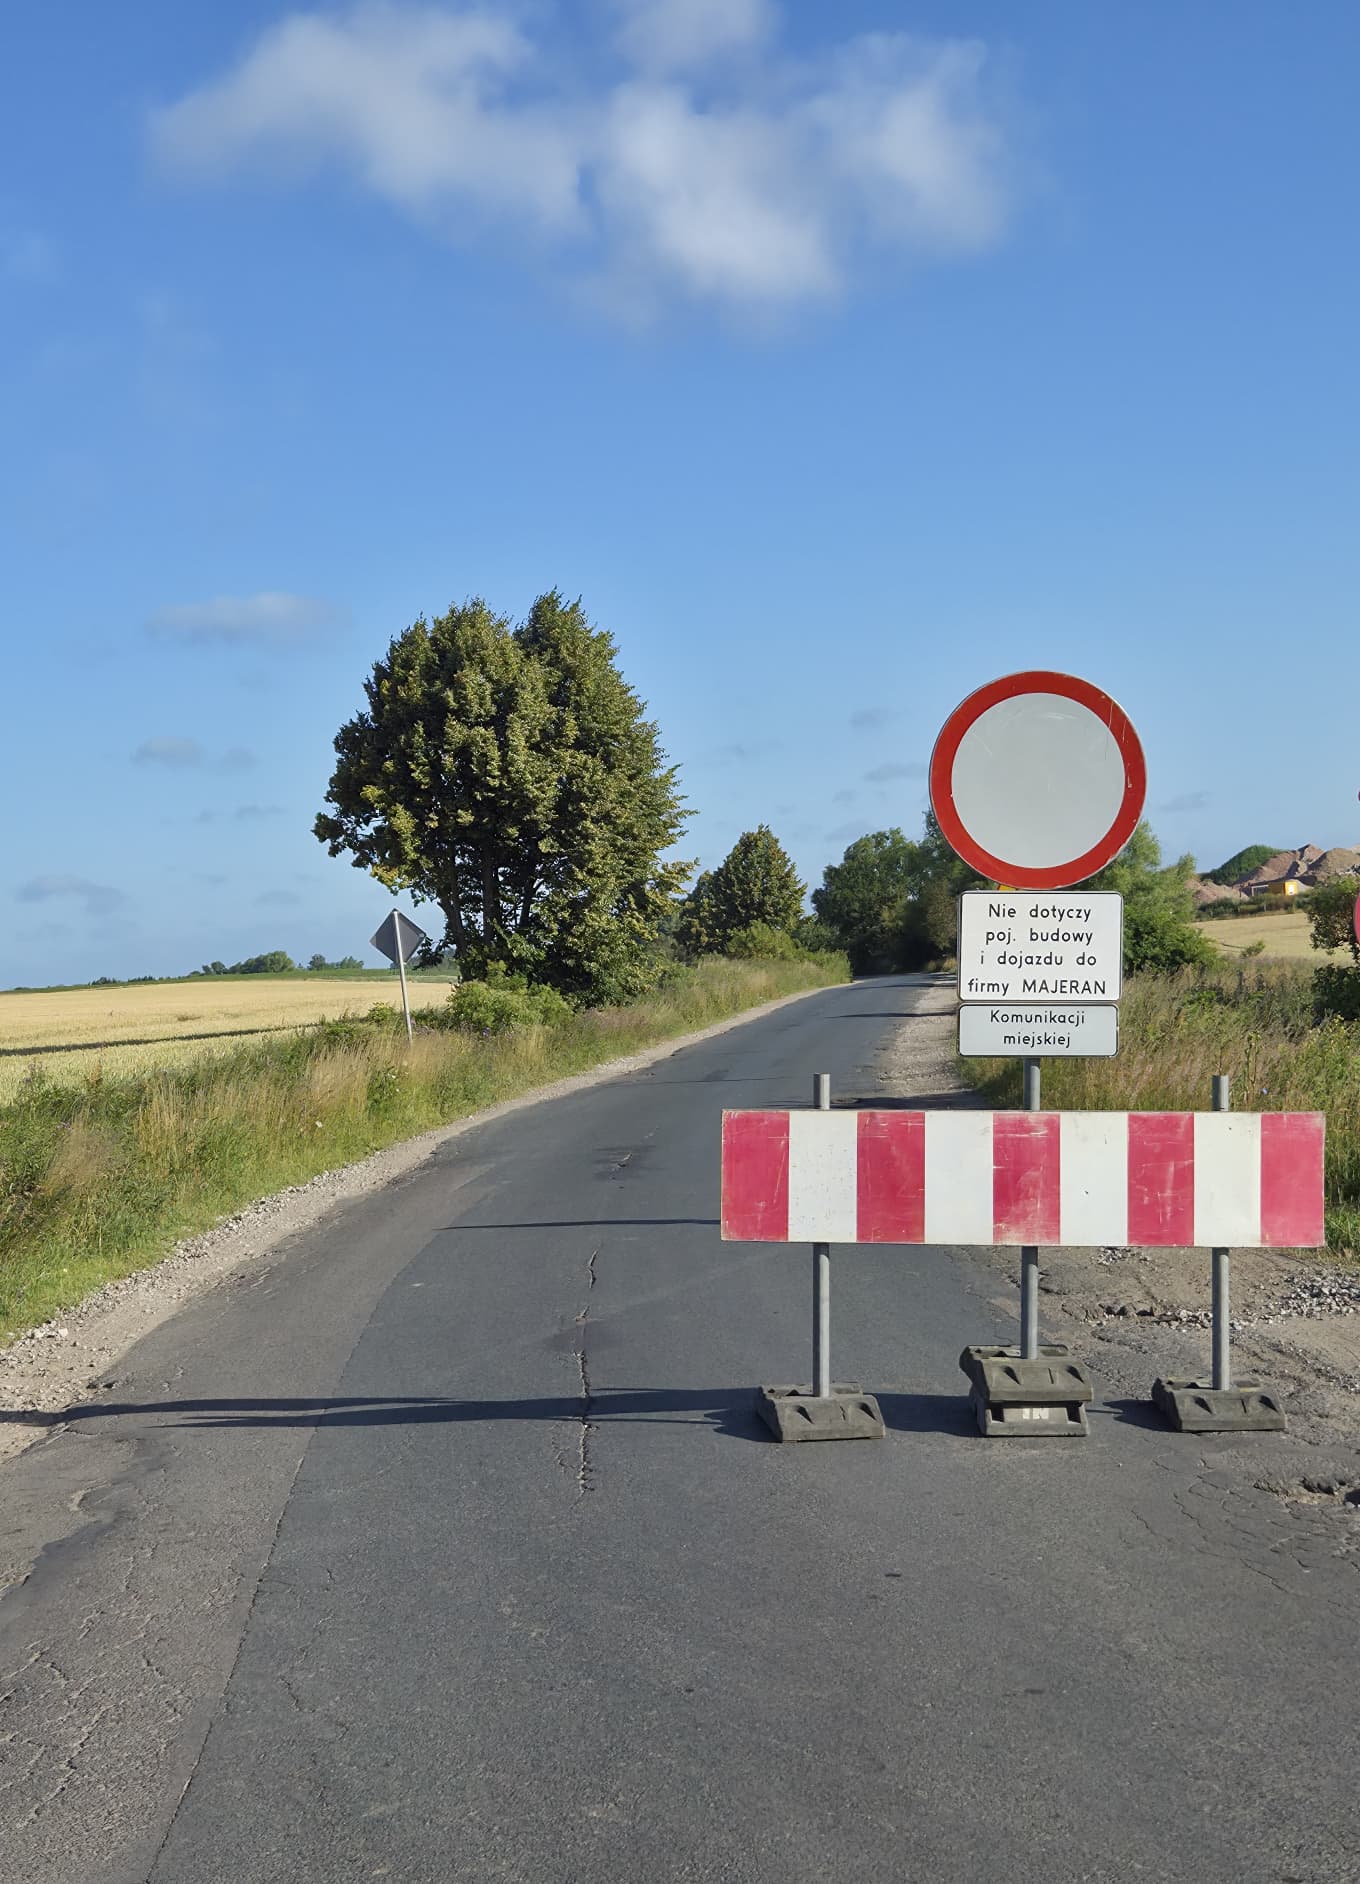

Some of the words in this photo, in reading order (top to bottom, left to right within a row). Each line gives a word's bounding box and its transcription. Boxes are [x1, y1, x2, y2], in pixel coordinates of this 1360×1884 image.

[989, 904, 1016, 918] Nie
[1029, 904, 1091, 922] dotyczy
[985, 927, 1016, 945] poj.
[1030, 927, 1093, 945] budowy
[980, 950, 985, 965] i
[997, 951, 1063, 968] dojazdu
[1076, 951, 1097, 966] do
[968, 978, 1009, 996] firmy
[1023, 979, 1106, 995] MAJERAN
[990, 1010, 1085, 1027] Komunikacji
[1003, 1031, 1070, 1049] miejskiej
